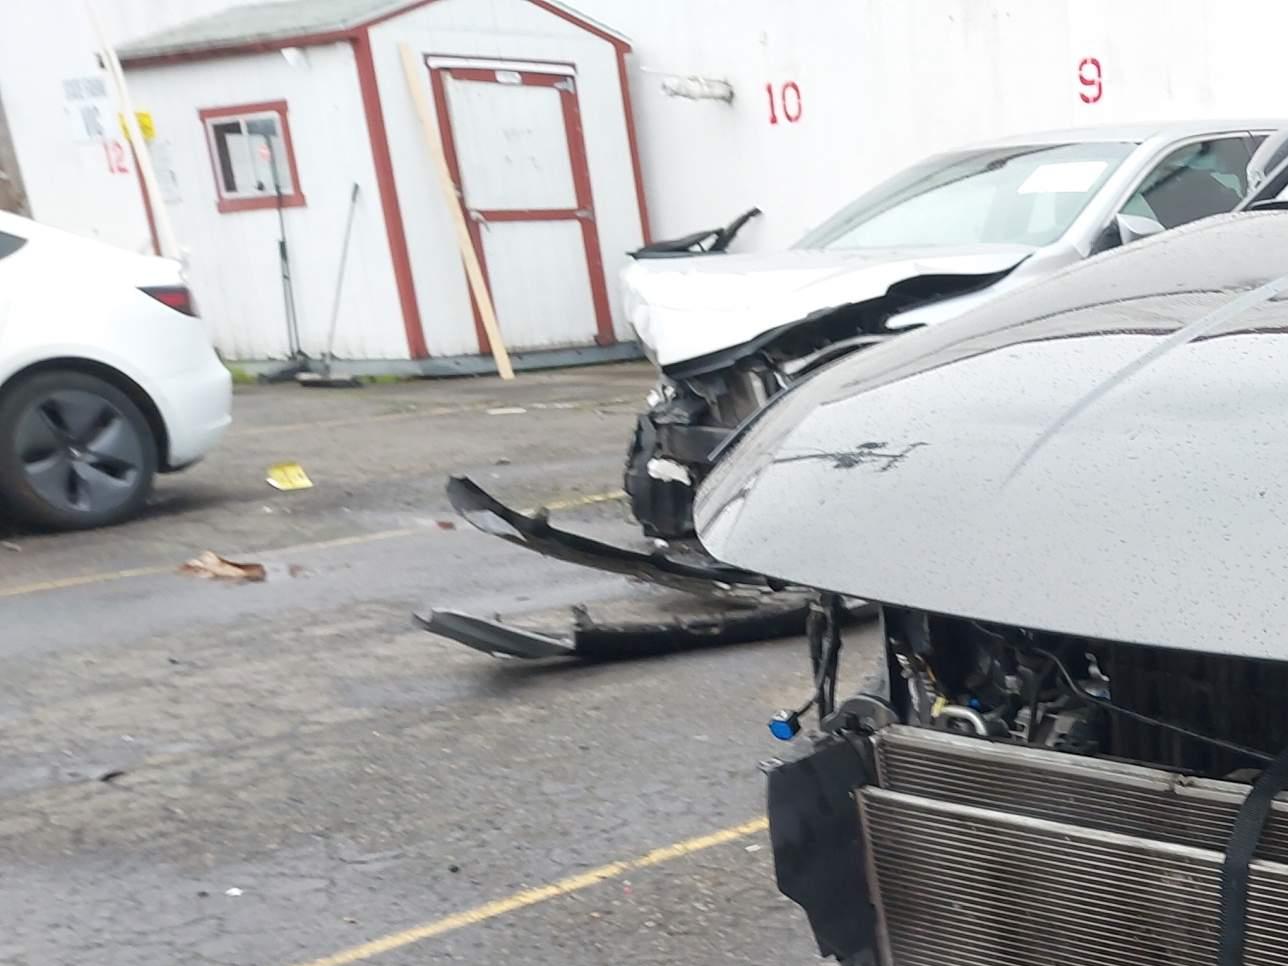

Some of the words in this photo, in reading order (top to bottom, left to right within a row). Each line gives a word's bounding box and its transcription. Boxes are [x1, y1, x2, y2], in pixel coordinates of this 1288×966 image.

[1078, 57, 1104, 104] 9
[765, 81, 802, 125] 10
[103, 140, 129, 174] 12
